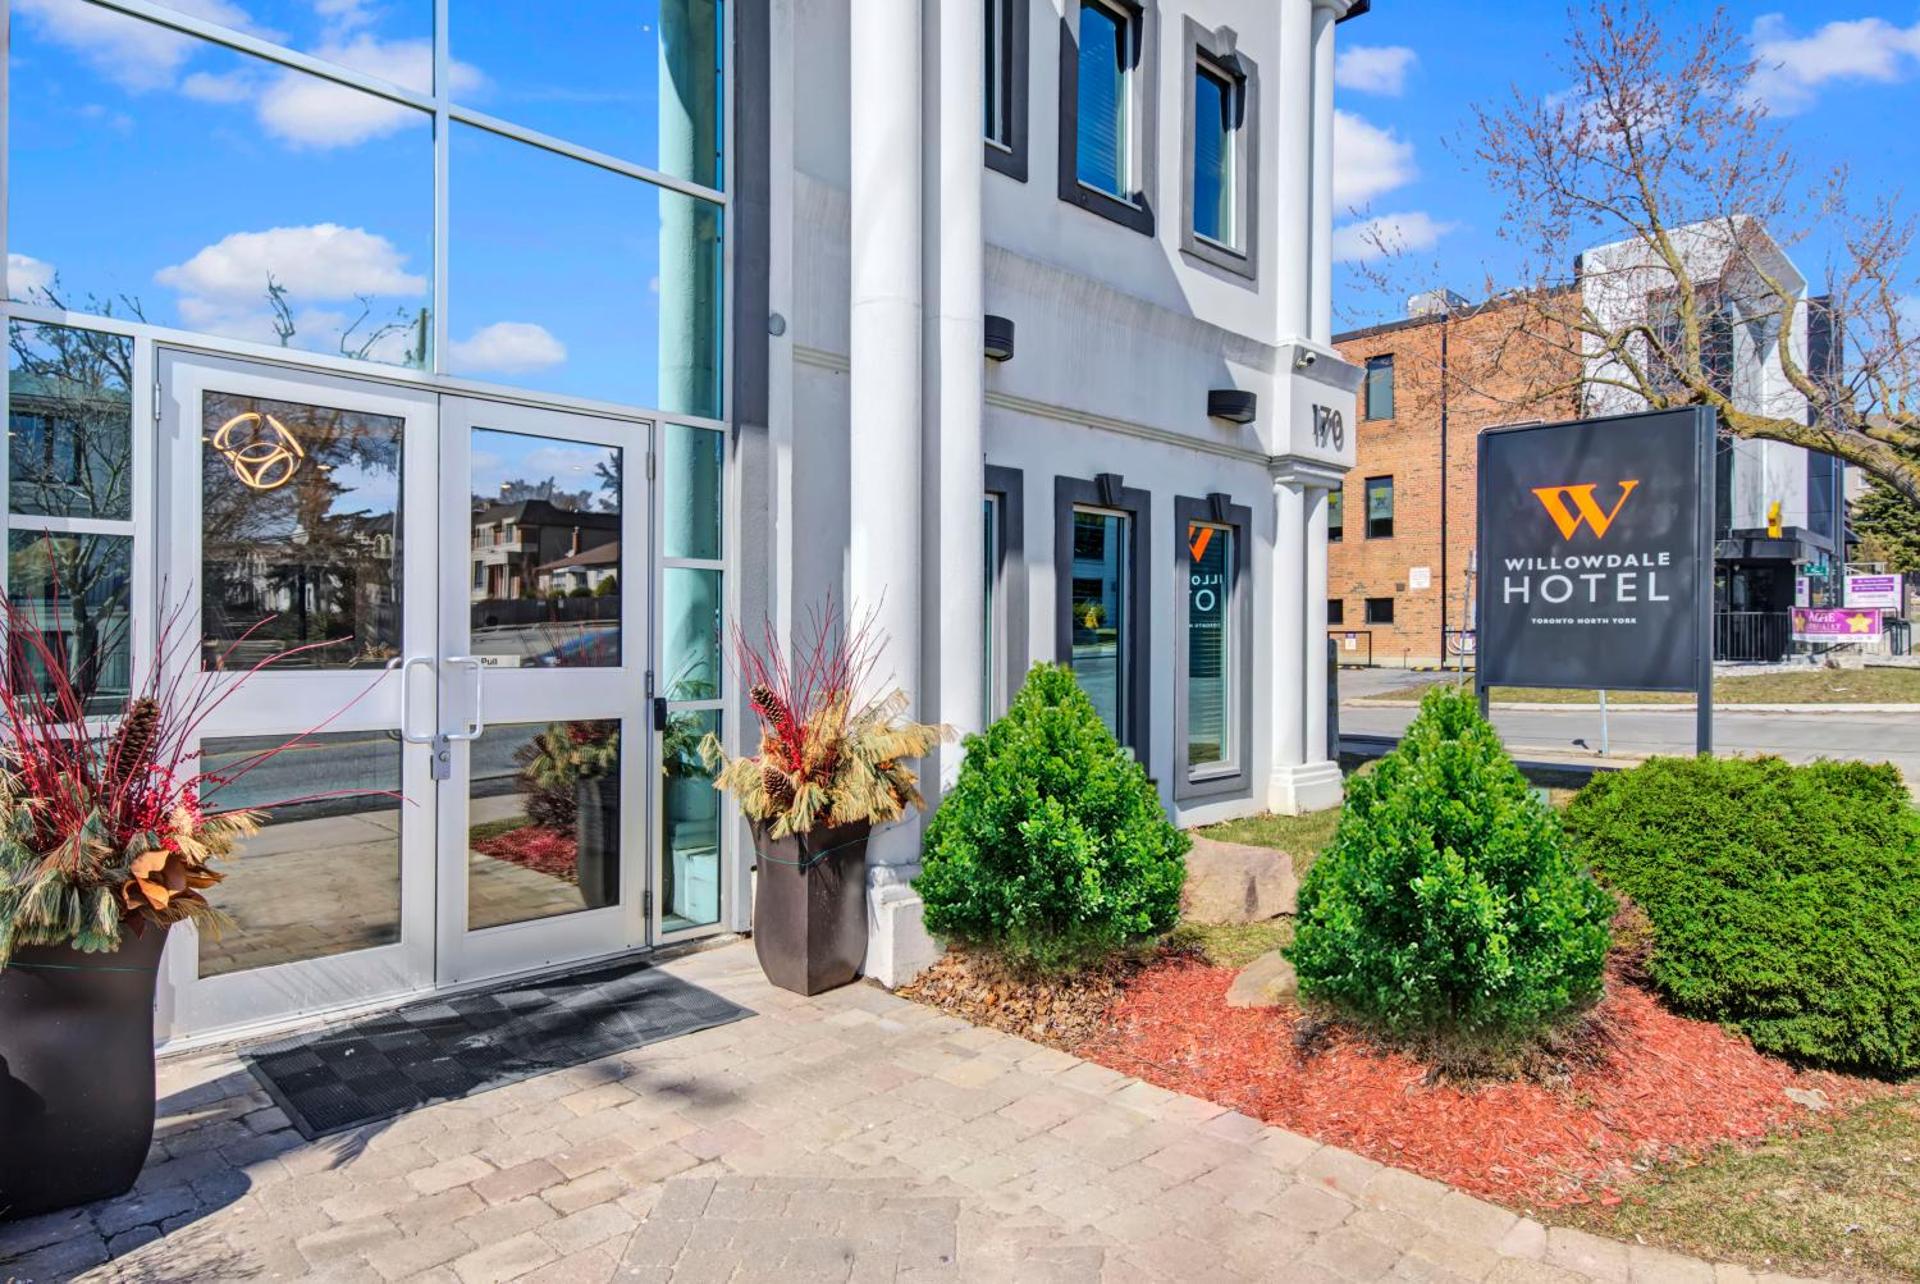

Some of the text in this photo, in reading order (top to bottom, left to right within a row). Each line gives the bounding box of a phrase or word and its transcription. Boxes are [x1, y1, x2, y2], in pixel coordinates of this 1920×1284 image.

[1312, 403, 1342, 442] 170
[1531, 480, 1639, 541] W
[1505, 552, 1670, 571] WILLOWDALE
[1503, 572, 1670, 604] HOTEL
